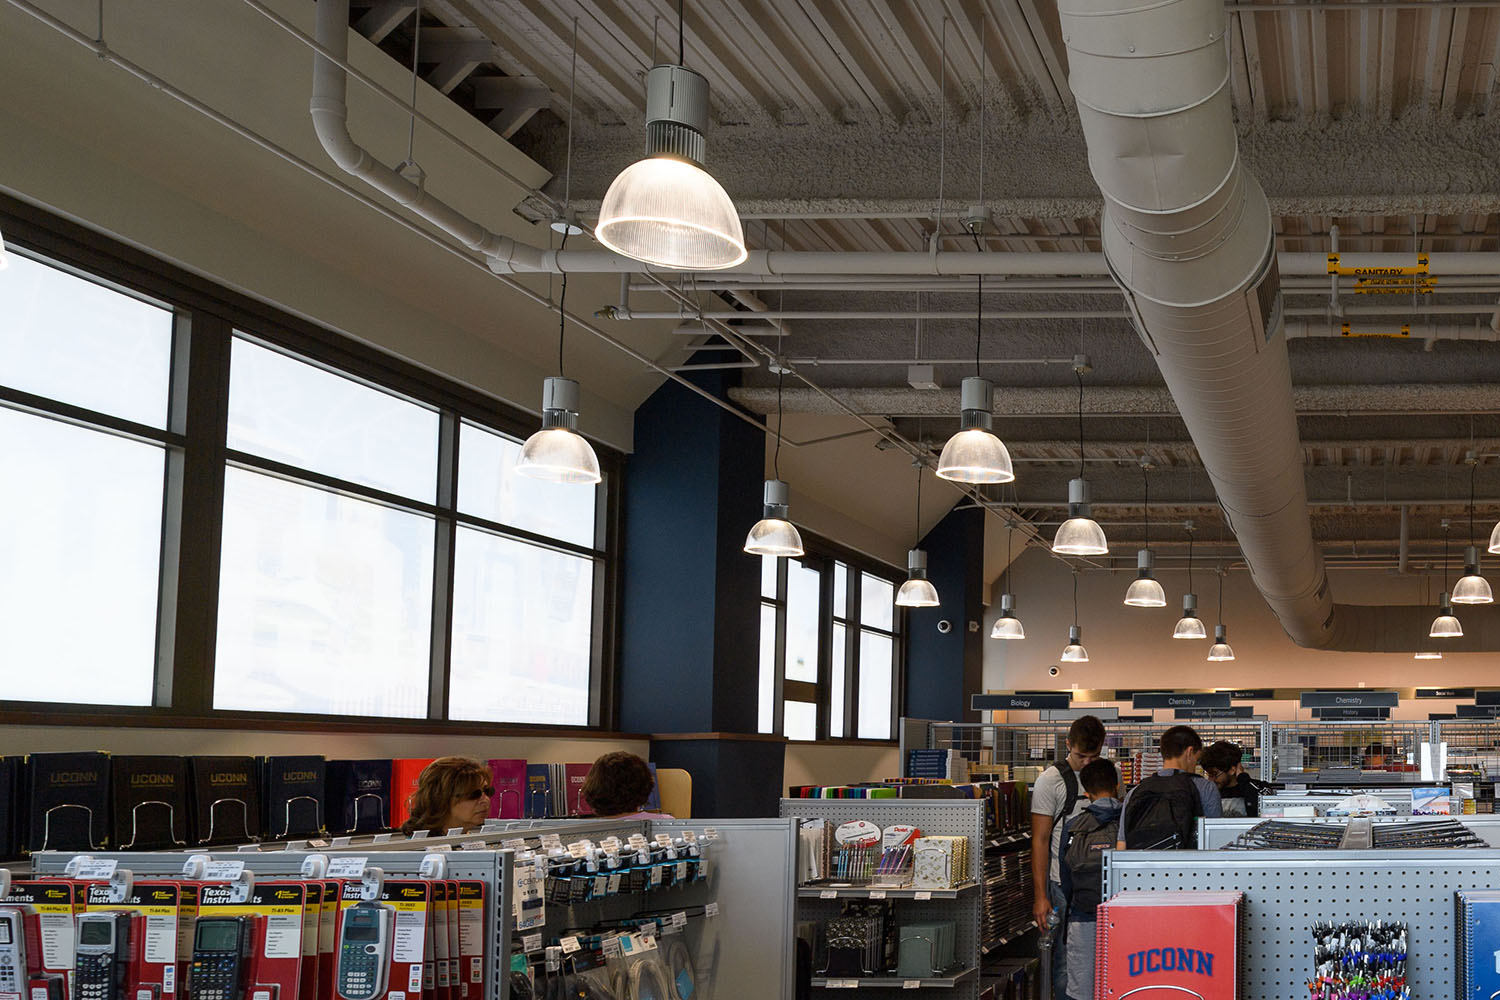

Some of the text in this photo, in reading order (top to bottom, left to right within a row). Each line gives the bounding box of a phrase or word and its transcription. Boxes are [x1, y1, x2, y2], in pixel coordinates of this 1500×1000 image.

[1010, 698, 1031, 709] Biology
[1168, 697, 1195, 707] Chemistry
[1335, 696, 1362, 706] Chemistry
[50, 772, 97, 783] UCONN
[130, 774, 174, 784] UCONN
[210, 773, 248, 783] UCONN
[283, 771, 317, 781] UCONN
[89, 887, 110, 897] Texa
[1128, 947, 1215, 980] UCONN
